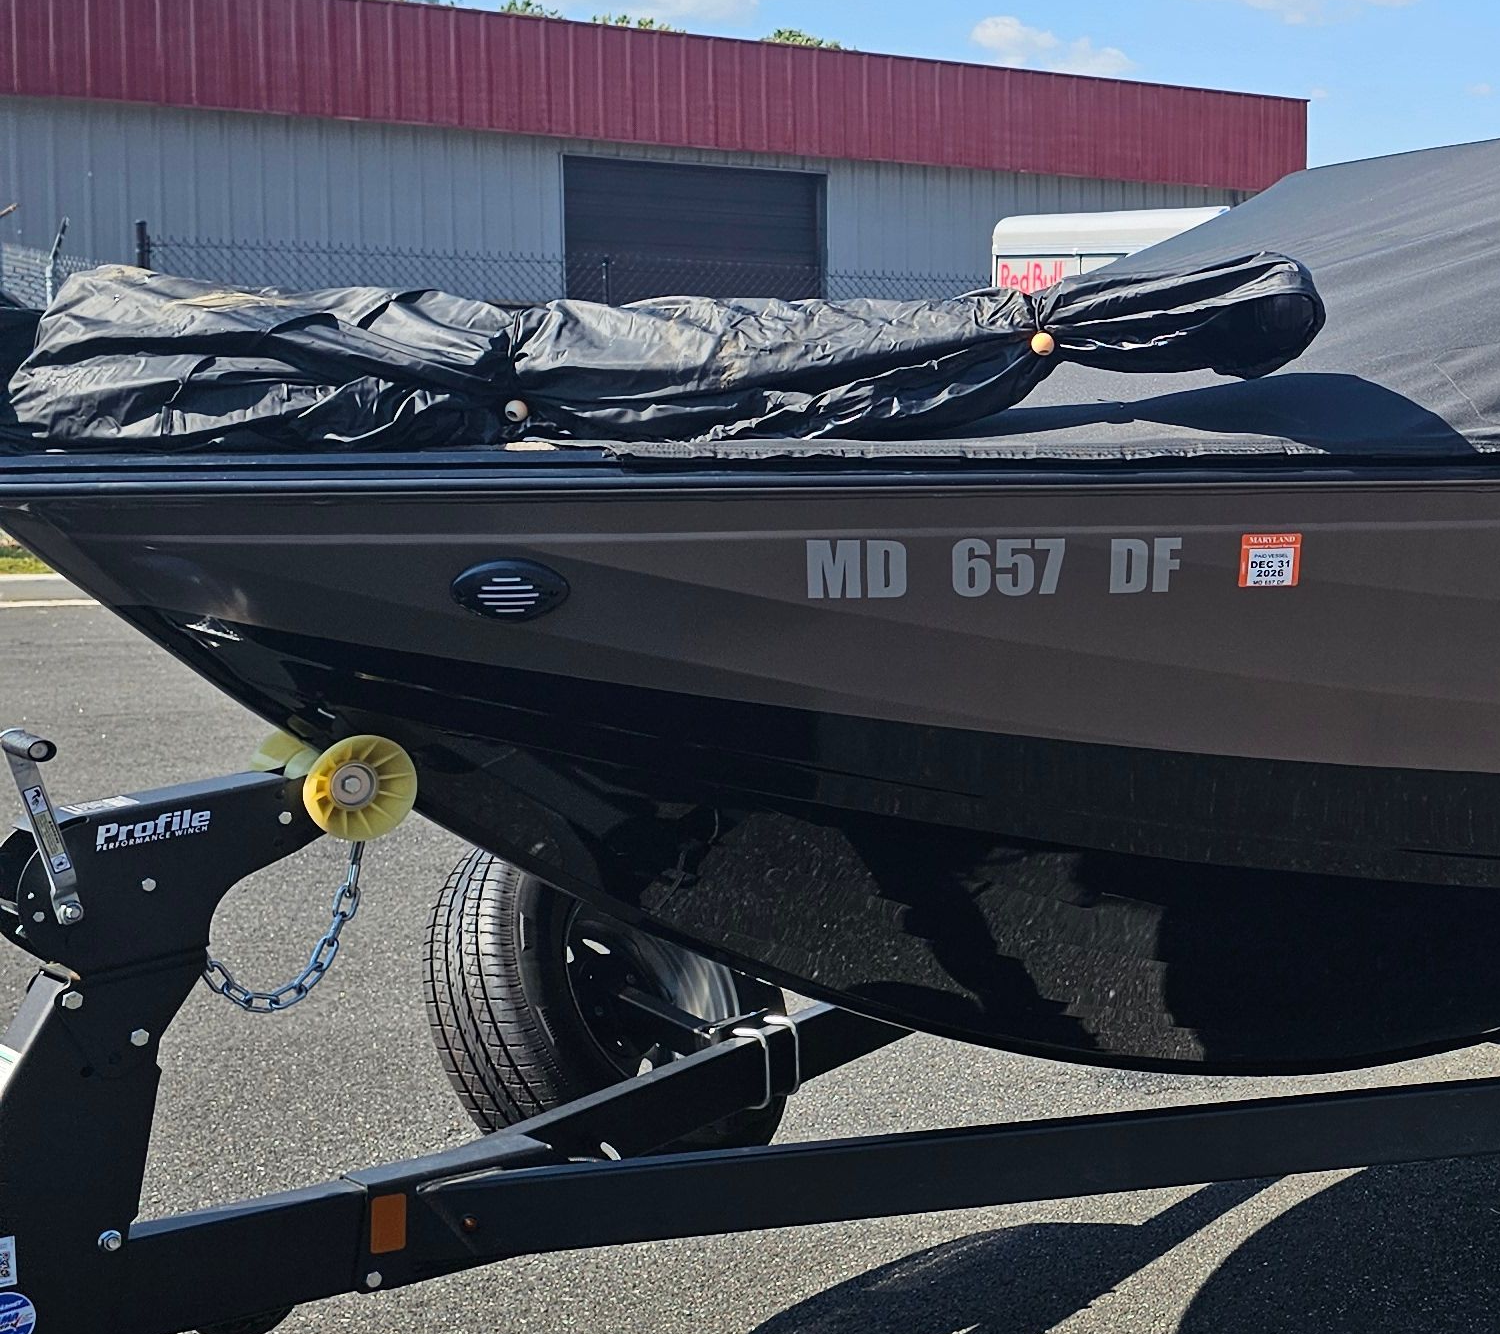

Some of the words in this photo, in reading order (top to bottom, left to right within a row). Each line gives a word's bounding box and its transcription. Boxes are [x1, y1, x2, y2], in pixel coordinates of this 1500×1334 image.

[1001, 261, 1030, 293] Red
[1033, 261, 1064, 288] Bull
[806, 539, 907, 598] MD
[951, 538, 1066, 597] 657
[1109, 537, 1183, 594] DF
[1256, 569, 1284, 577] 2026
[1277, 559, 1290, 568] 31
[96, 809, 211, 846] Profile
[96, 831, 171, 852] PERFORMANCE
[175, 825, 208, 837] WINCH
